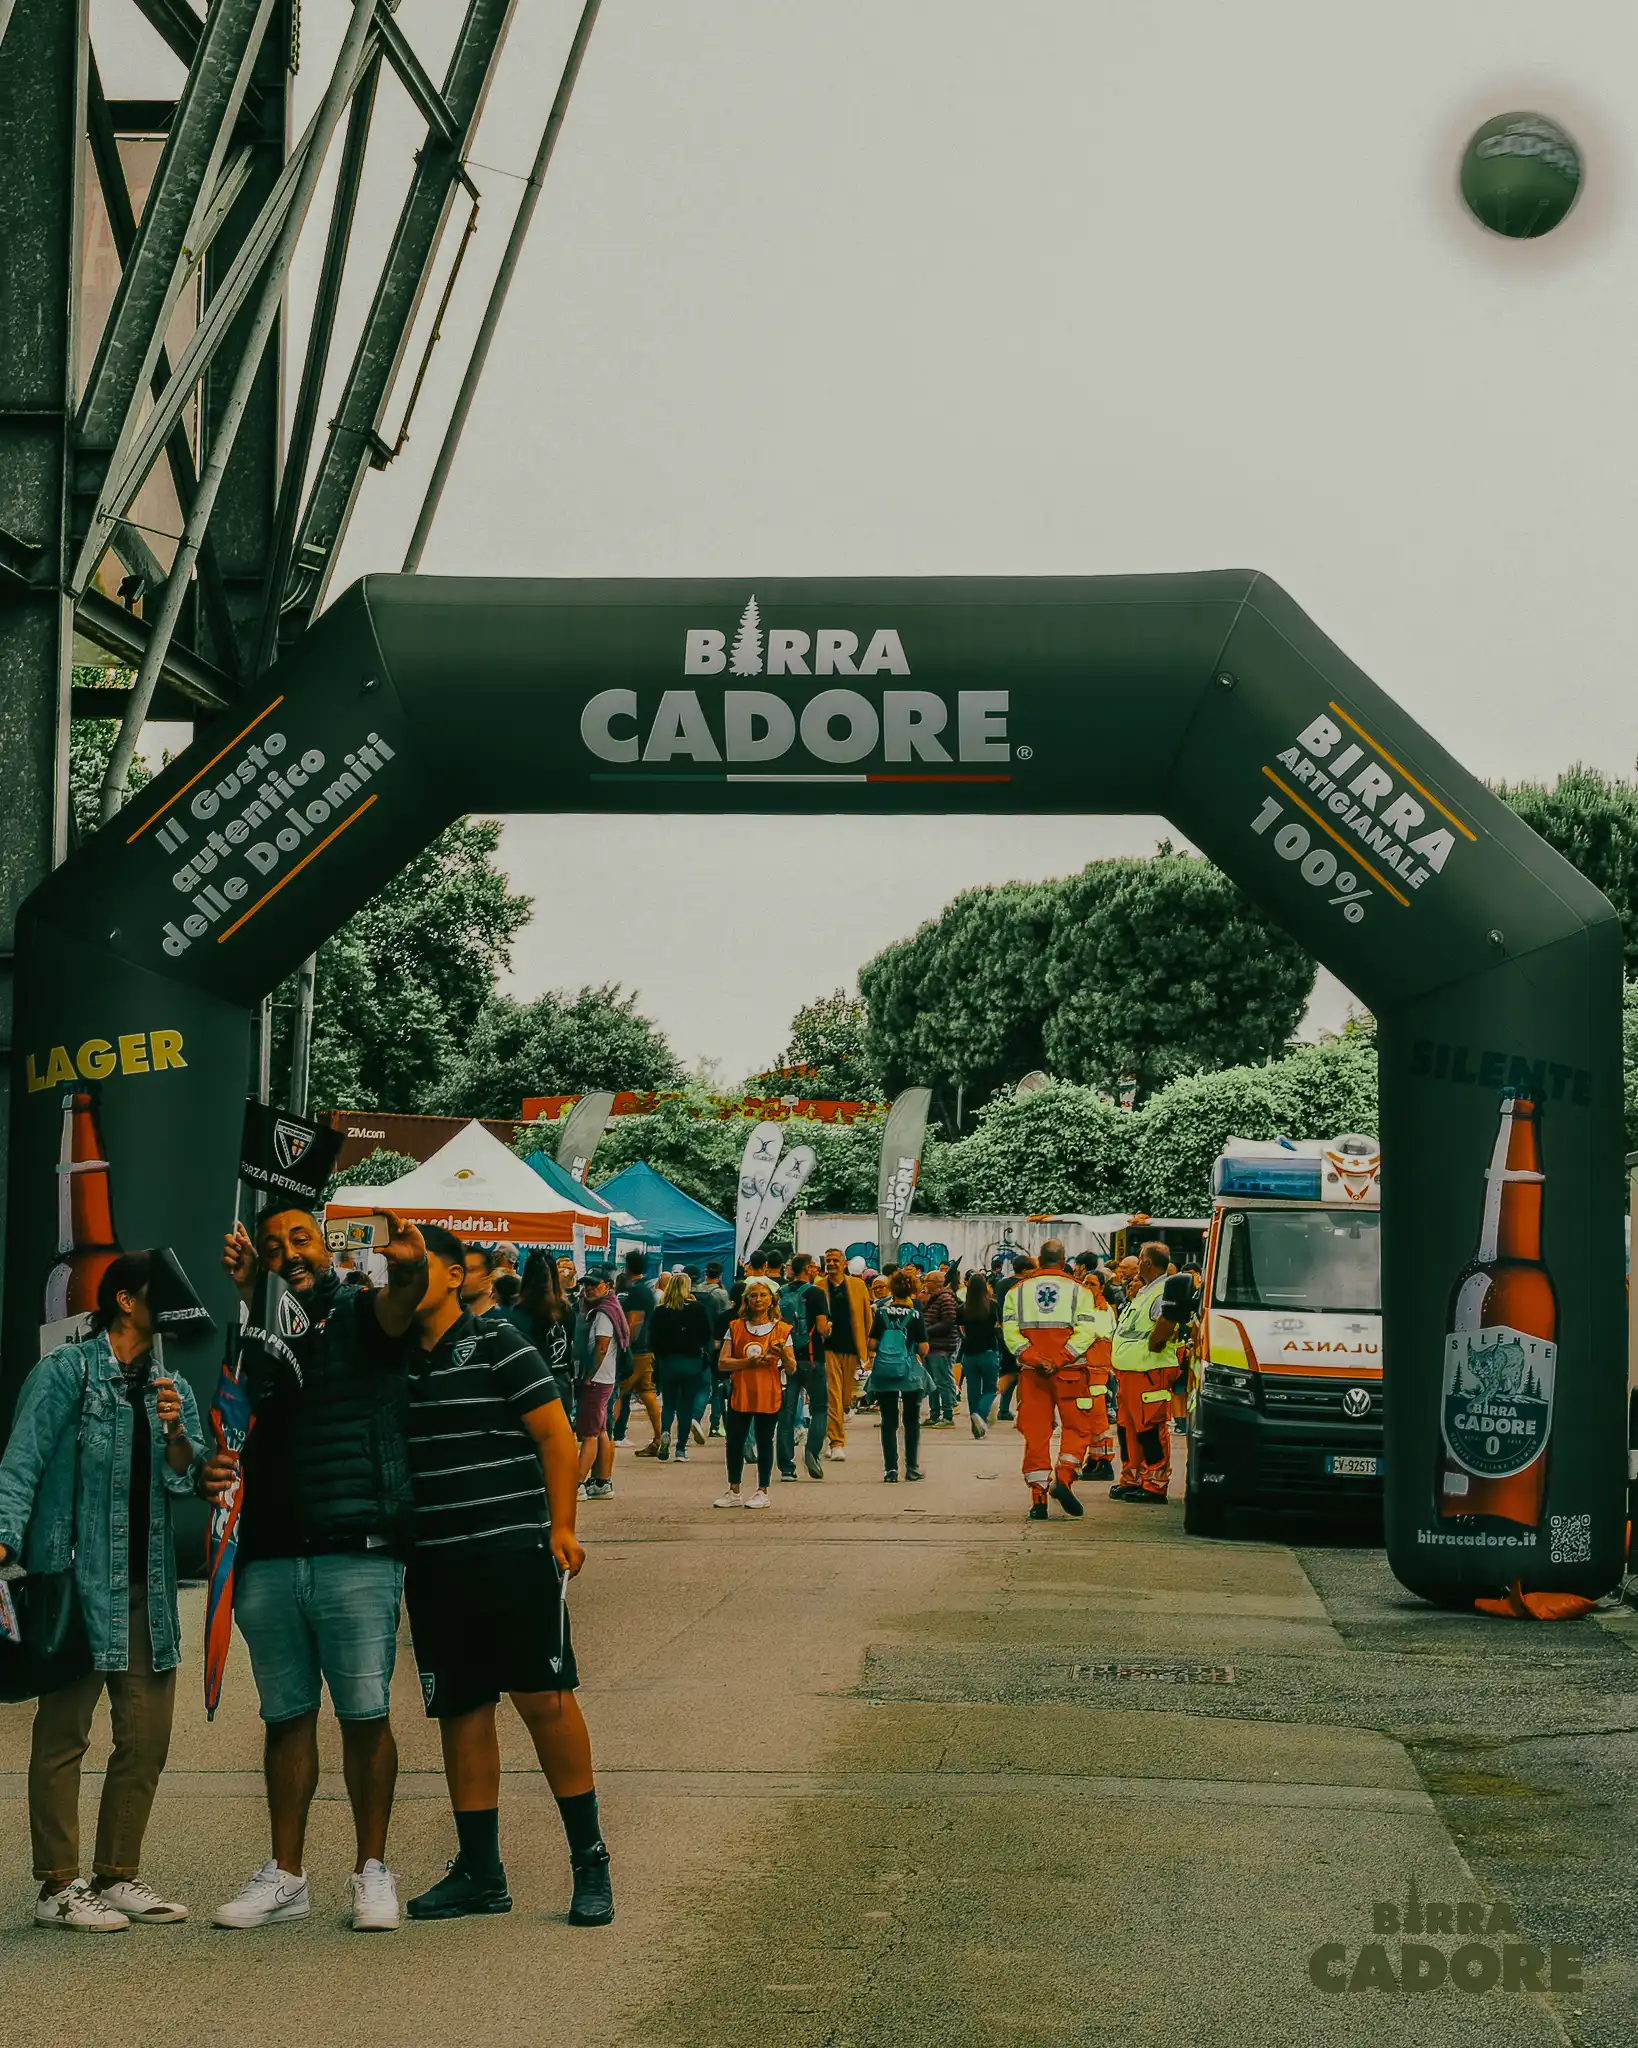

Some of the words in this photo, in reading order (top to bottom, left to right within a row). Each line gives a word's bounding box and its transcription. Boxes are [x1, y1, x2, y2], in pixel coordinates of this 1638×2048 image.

[684, 596, 911, 676] BIRRA
[580, 688, 1011, 763] CADORE
[155, 816, 190, 855] Il
[191, 732, 287, 820] Gusto
[172, 749, 326, 893] autentico
[1275, 746, 1431, 890] ARTIGIANALE
[1296, 713, 1456, 875] BIRRA
[162, 876, 249, 957] delle
[243, 732, 396, 876] Dolomiti
[1250, 796, 1374, 923] 100%
[26, 1029, 188, 1093] LAGER
[1408, 1039, 1593, 1107] SILENTE
[241, 1161, 268, 1182] FORZA
[270, 1172, 317, 1199] PETRARCA
[892, 1156, 915, 1239] CADORE
[1451, 1333, 1552, 1359] SILENTE
[1454, 1413, 1537, 1436] CADORE
[1472, 1403, 1518, 1417] BIRRA
[1418, 1529, 1537, 1547] birracadore.it
